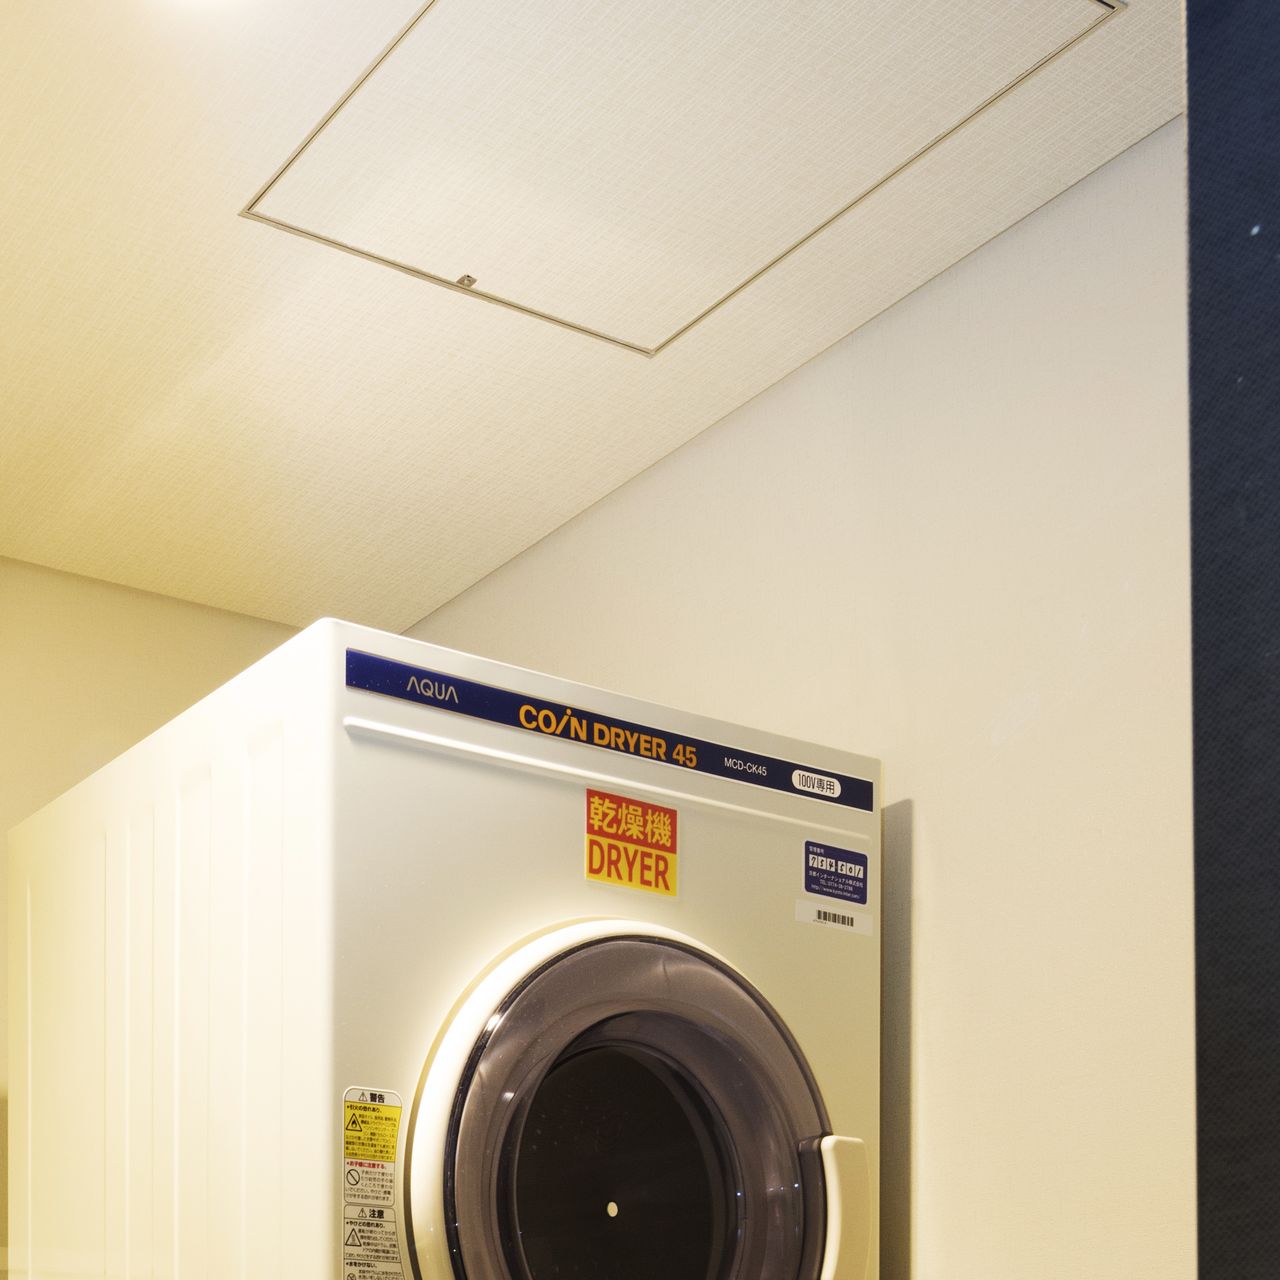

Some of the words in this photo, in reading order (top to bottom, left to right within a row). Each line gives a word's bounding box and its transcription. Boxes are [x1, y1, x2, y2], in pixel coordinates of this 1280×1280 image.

[406, 677, 459, 704] AQUA
[594, 725, 667, 760] DRYER
[672, 744, 697, 768] 45
[724, 757, 767, 776] MCD-CK45
[798, 774, 835, 794] 100V専用
[588, 797, 672, 847] 乾燥機
[588, 838, 670, 891] DRYER
[369, 1209, 384, 1218] 注意
